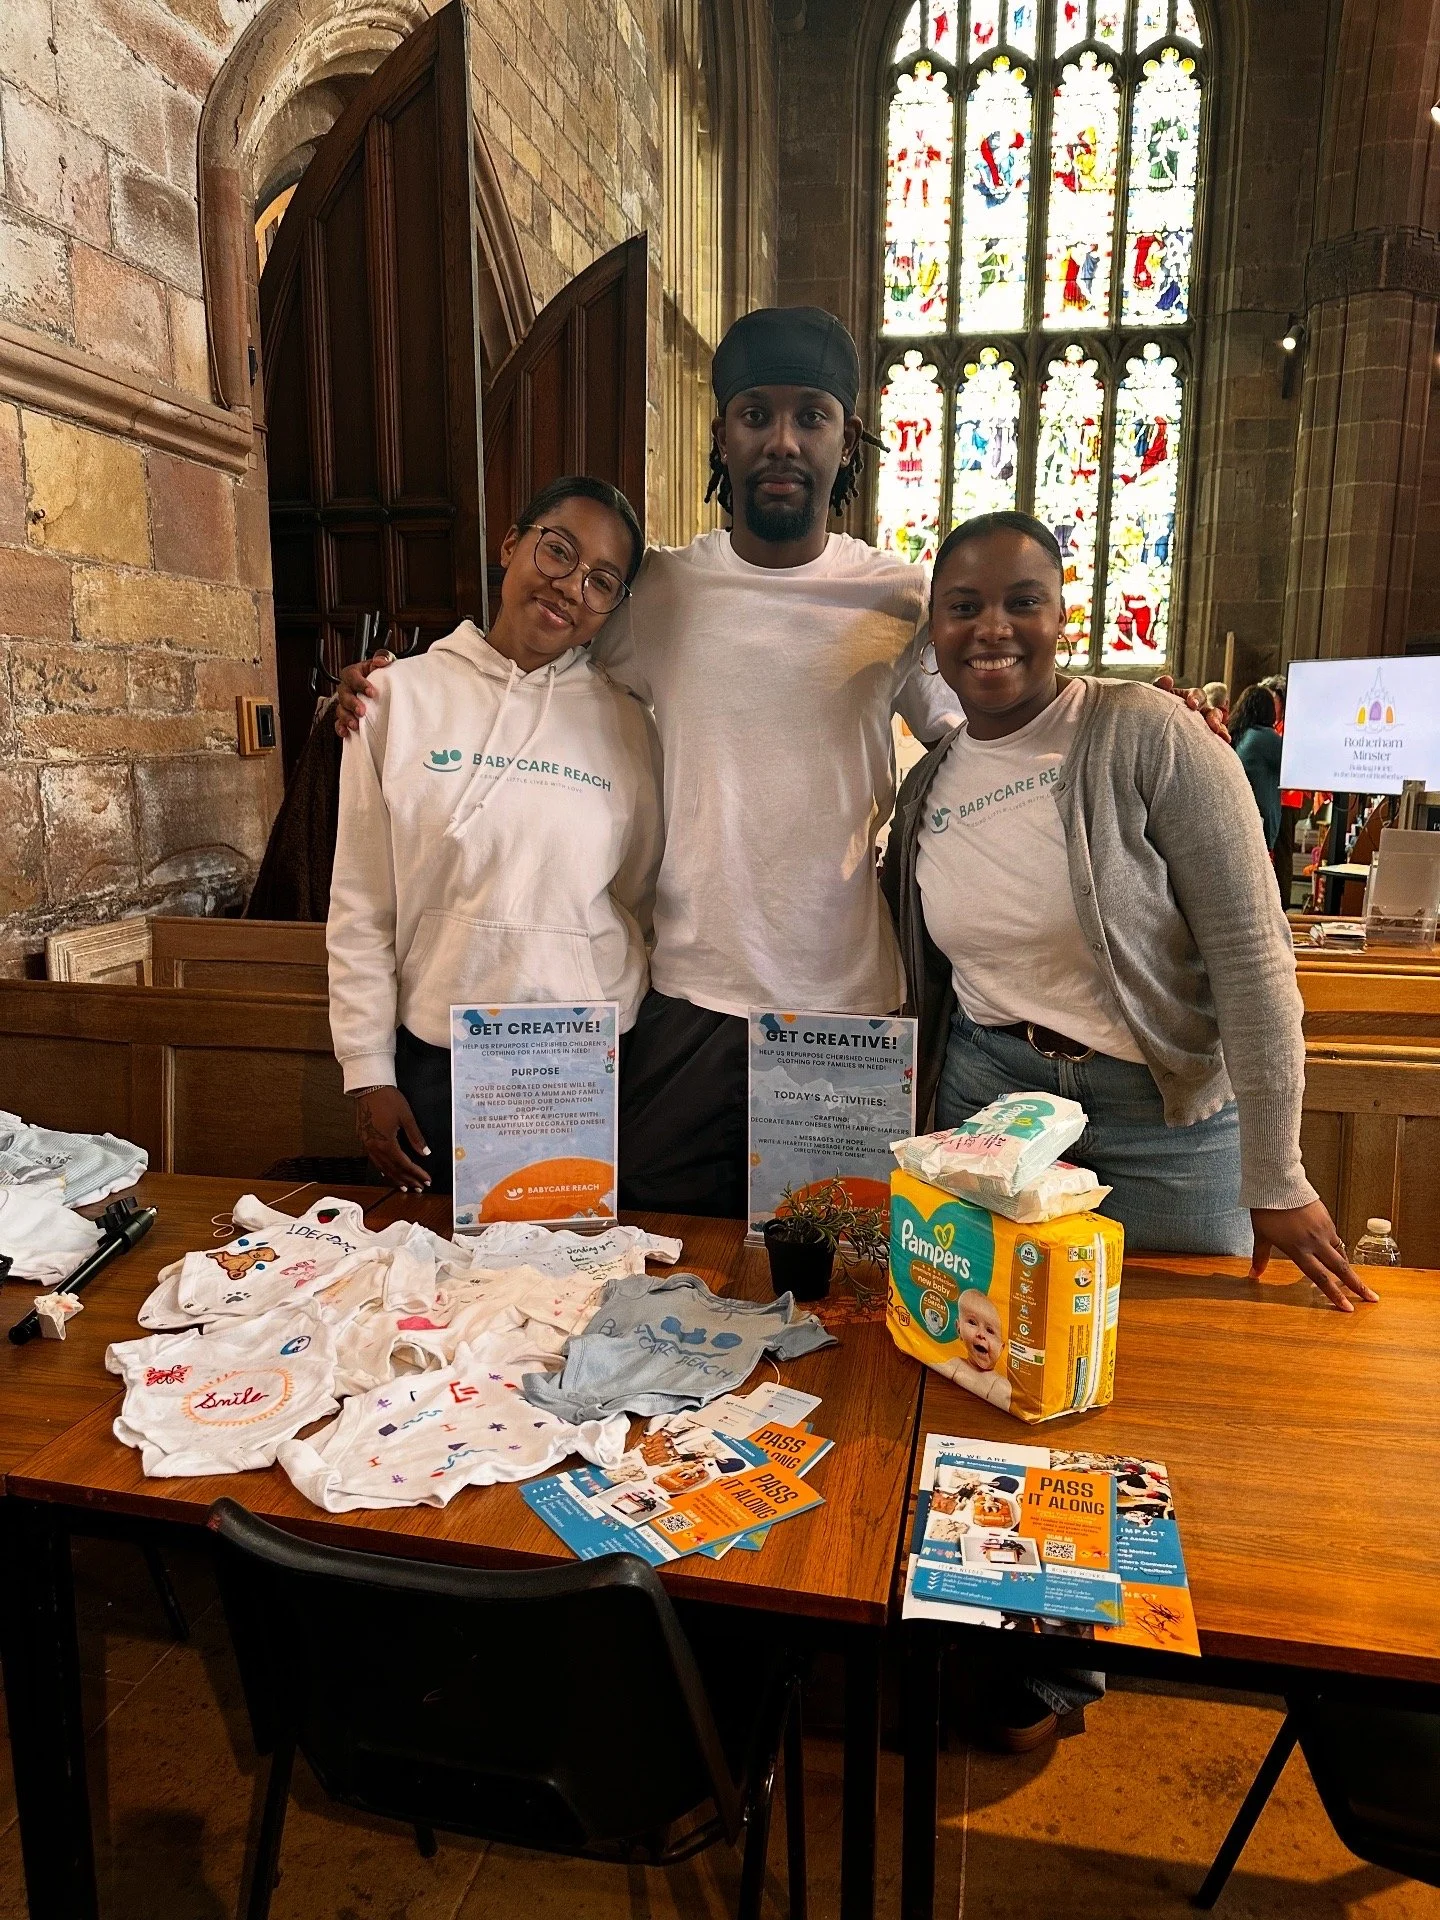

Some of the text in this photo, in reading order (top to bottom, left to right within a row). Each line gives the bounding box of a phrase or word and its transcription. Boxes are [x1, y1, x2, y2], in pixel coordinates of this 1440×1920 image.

[1344, 737, 1403, 748] Rotherham
[1353, 750, 1392, 761] Minster
[472, 753, 611, 792] BABYCARE REACH
[959, 777, 1035, 818] BABYCARE
[469, 1021, 600, 1035] GET CREATIVE!
[765, 1030, 897, 1050] GET CREATIVE!
[776, 1057, 811, 1065] CLOTHING
[827, 1061, 857, 1069] FAMILIES
[866, 1063, 887, 1071] NEED!
[786, 1051, 824, 1060] REPURPOSE
[825, 1053, 863, 1062] CHERISHED
[864, 1056, 904, 1065] CHILDREN'S
[511, 1066, 560, 1076] PURPOSE
[496, 1083, 541, 1091] DECORATED
[774, 1090, 887, 1107] TODAY'S ACTIVITIES:
[487, 1121, 534, 1129] BEAUTIFULLY
[750, 1116, 785, 1125] DECORATE
[804, 1120, 832, 1129] ONESIES
[833, 1123, 851, 1131] WITH
[852, 1125, 876, 1133] FABRIC
[782, 1140, 813, 1148] HEARTFELT
[813, 1142, 841, 1150] MESSAGE
[799, 1135, 834, 1143] MESSAGES
[793, 1147, 821, 1155] DIRECTLY
[527, 1183, 600, 1194] BABYCARE REACH
[901, 1219, 971, 1279] Pampers
[917, 1275, 951, 1298] new baby
[194, 1386, 269, 1409] Smile
[755, 1430, 806, 1453] PASS
[720, 1478, 744, 1491] IT
[750, 1473, 799, 1504] PASS
[1040, 1476, 1094, 1498] PASS
[731, 1488, 778, 1519] ALONG
[1028, 1492, 1105, 1516] IT ALONG
[1120, 1527, 1166, 1537] IMPACT
[1128, 1548, 1157, 1556] Mothers
